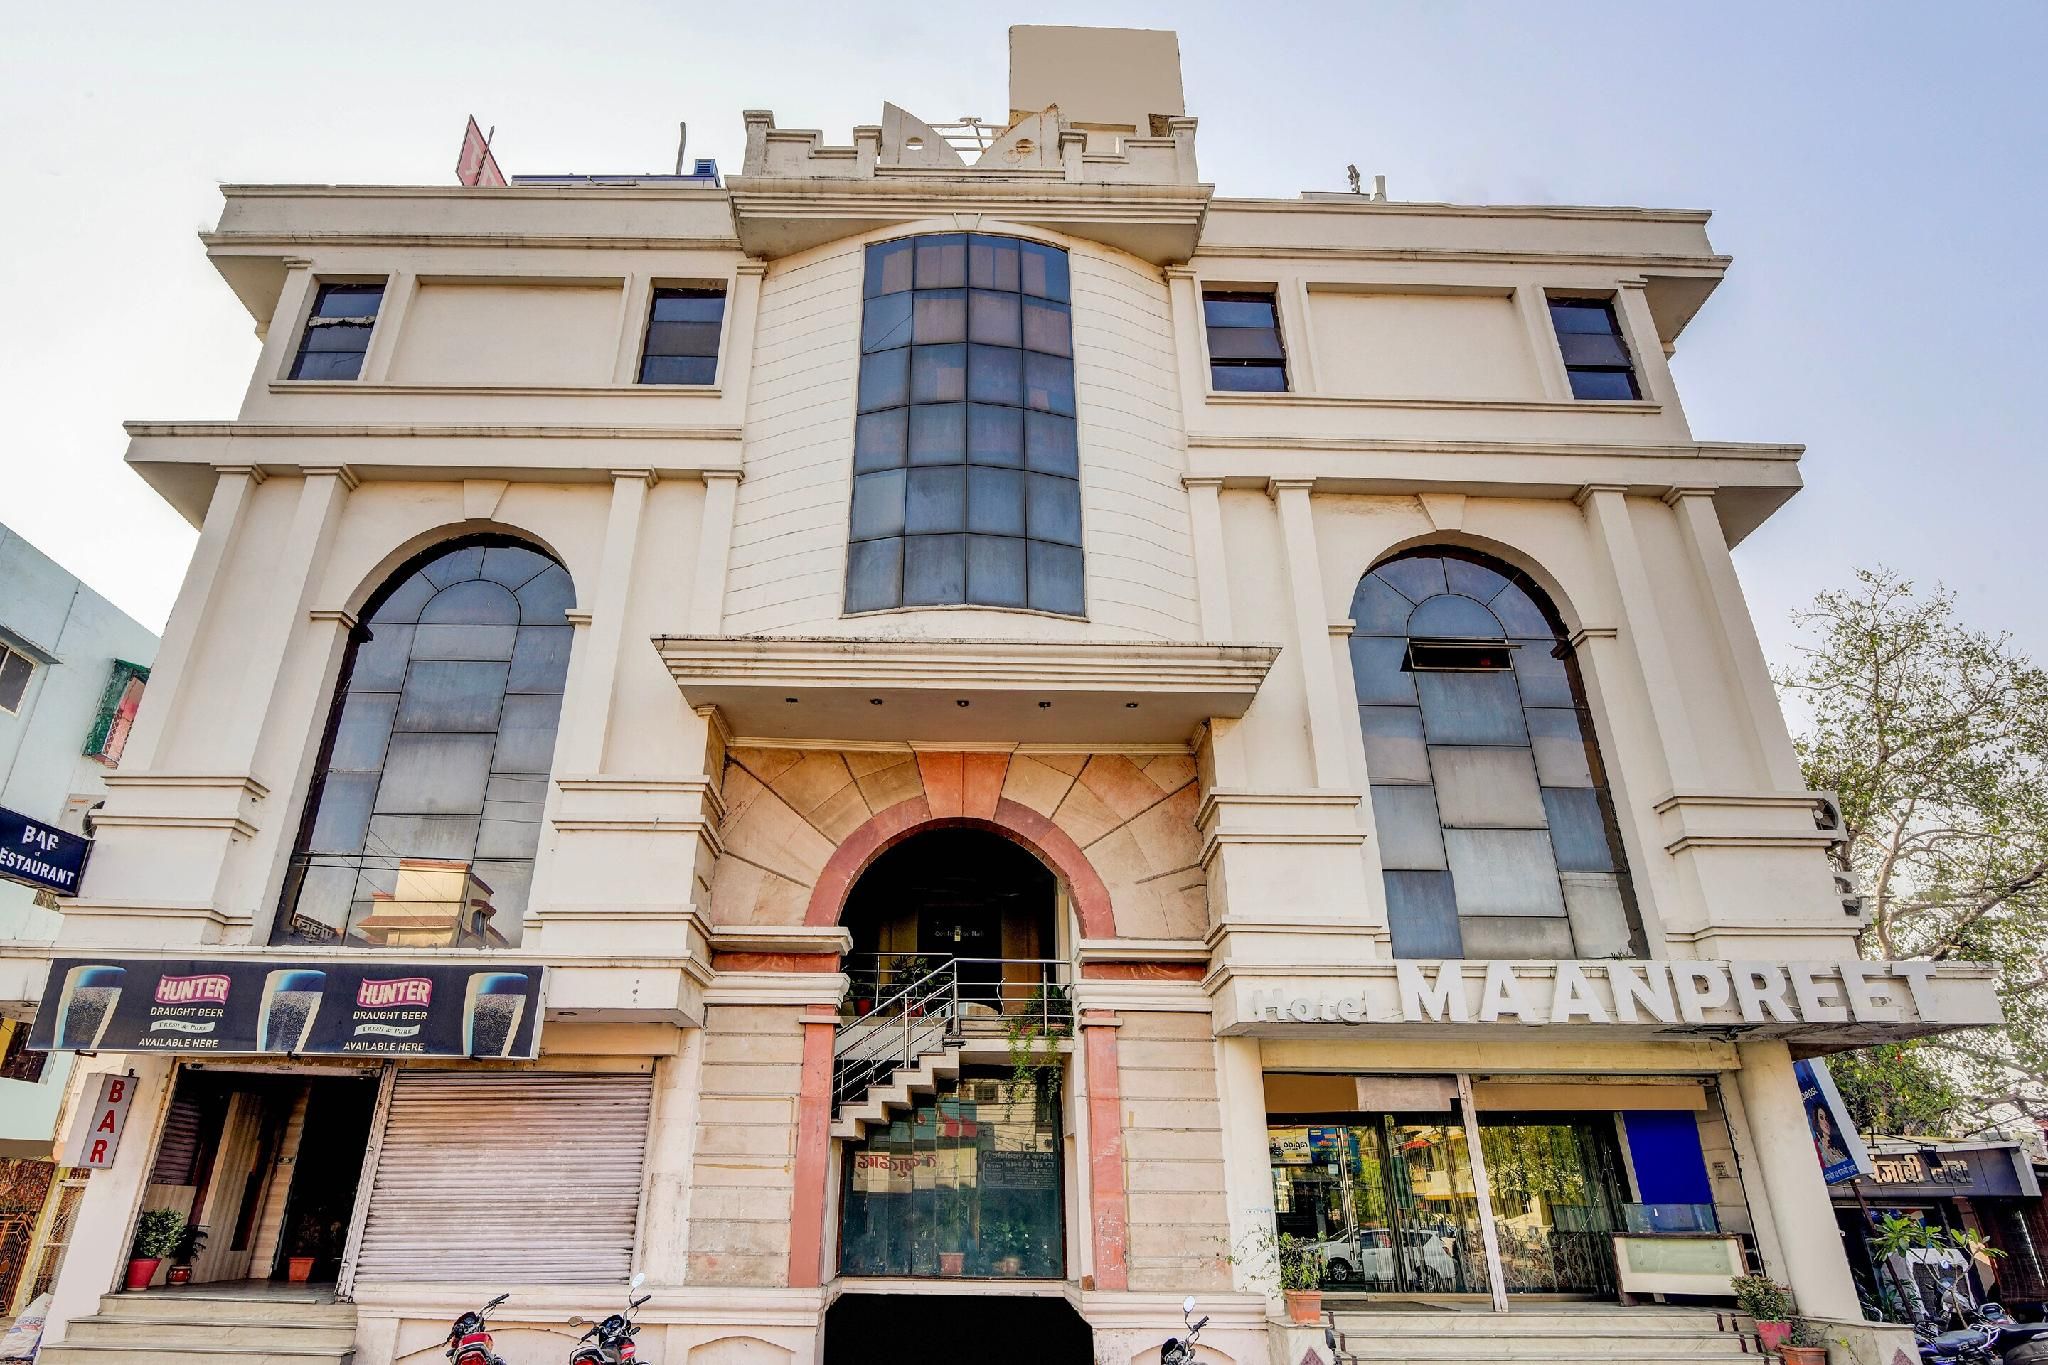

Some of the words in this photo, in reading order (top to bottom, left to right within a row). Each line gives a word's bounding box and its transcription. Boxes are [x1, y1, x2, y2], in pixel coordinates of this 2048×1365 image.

[157, 977, 228, 1001] HUNTER
[359, 980, 431, 1005] HUNTER
[1253, 988, 1380, 1025] Hotel
[1397, 960, 1937, 1024] MAANPREET
[150, 1007, 196, 1016] DRAUGHT
[197, 1008, 224, 1017] BEER
[353, 1011, 400, 1020] DRAUGHT
[401, 1011, 428, 1020] BEER
[138, 1038, 192, 1047] AVAILABLE
[192, 1039, 219, 1048] HERE
[343, 1042, 397, 1051] AVAILABLE
[398, 1042, 425, 1051] HERE
[90, 1079, 125, 1163] BAR
